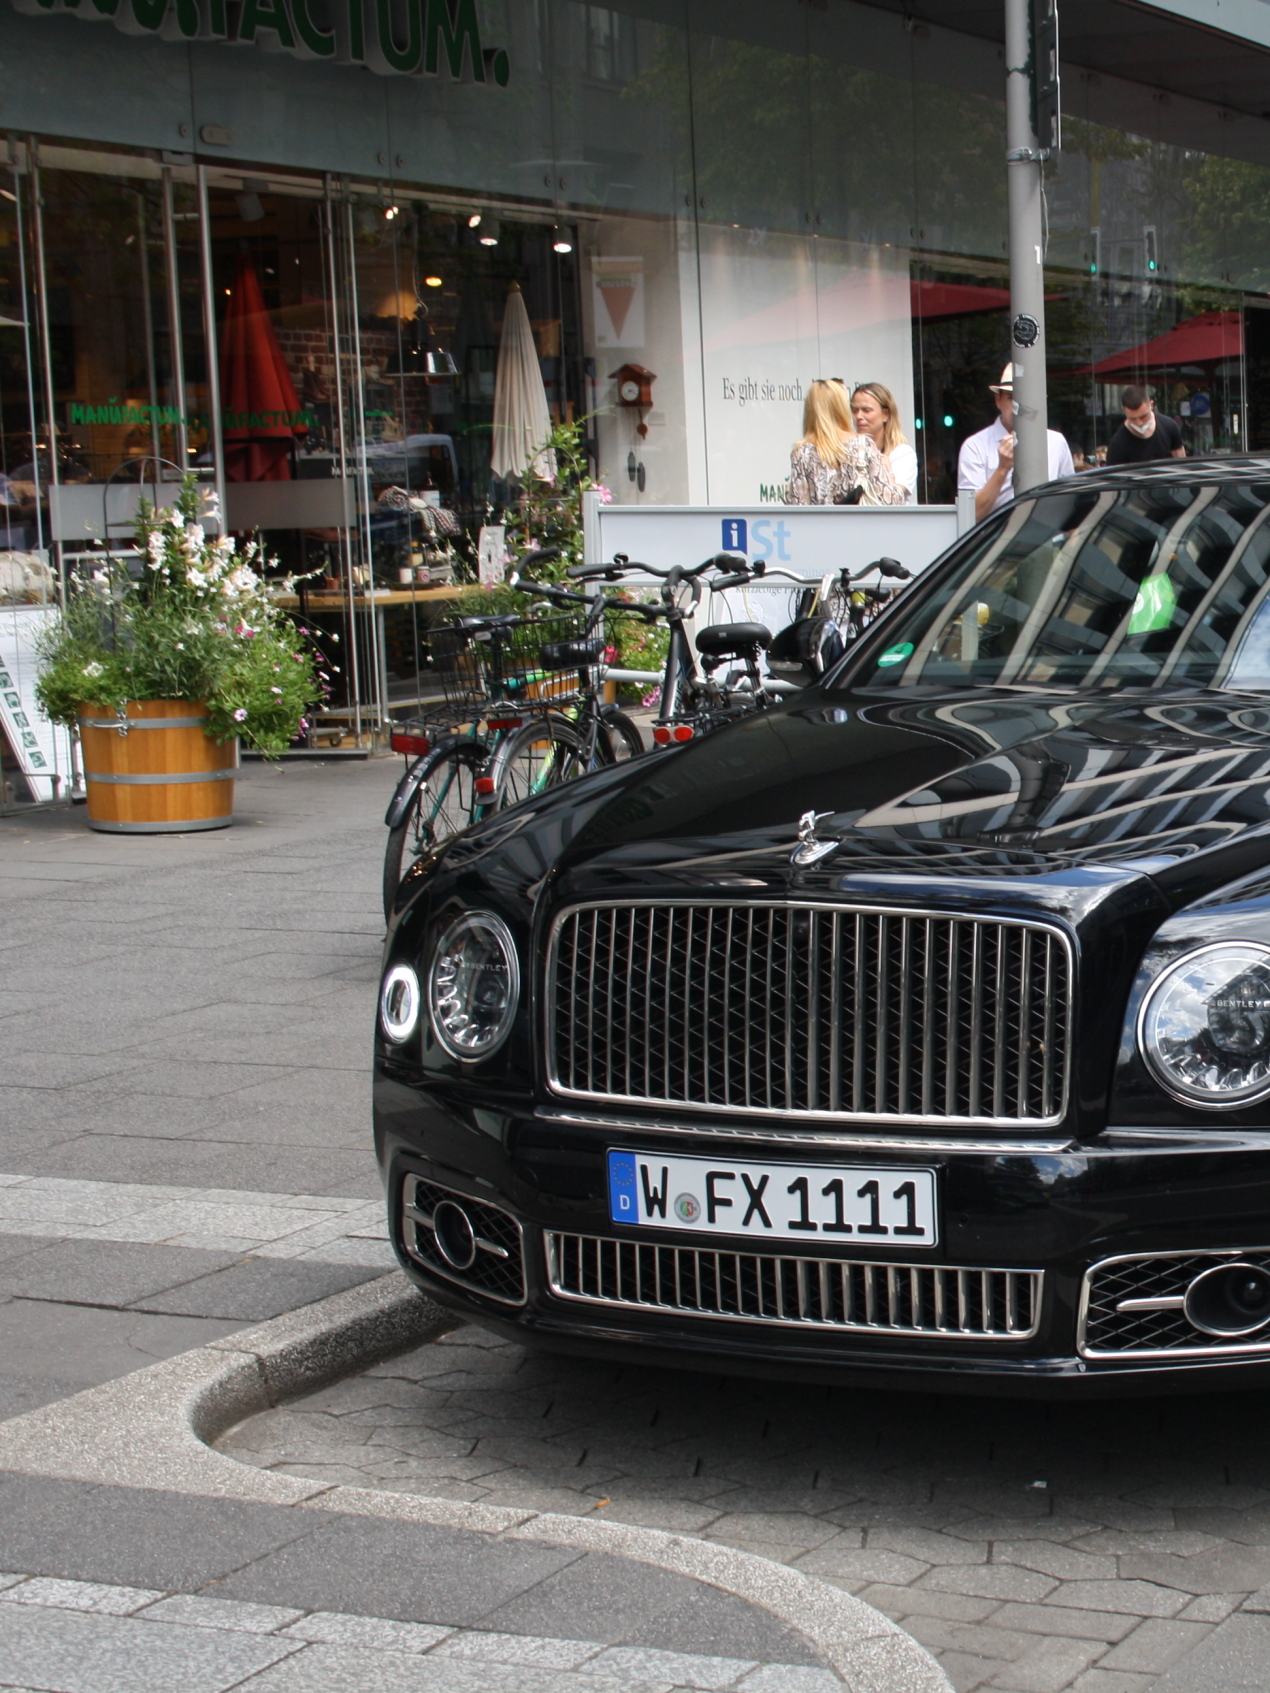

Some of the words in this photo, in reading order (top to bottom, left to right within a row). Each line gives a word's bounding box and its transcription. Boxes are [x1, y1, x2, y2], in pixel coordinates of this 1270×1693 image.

[722, 377, 736, 400] Es
[738, 376, 759, 407] gibt
[761, 379, 776, 401] sie
[619, 1195, 630, 1210] D
[640, 1164, 668, 1219] W
